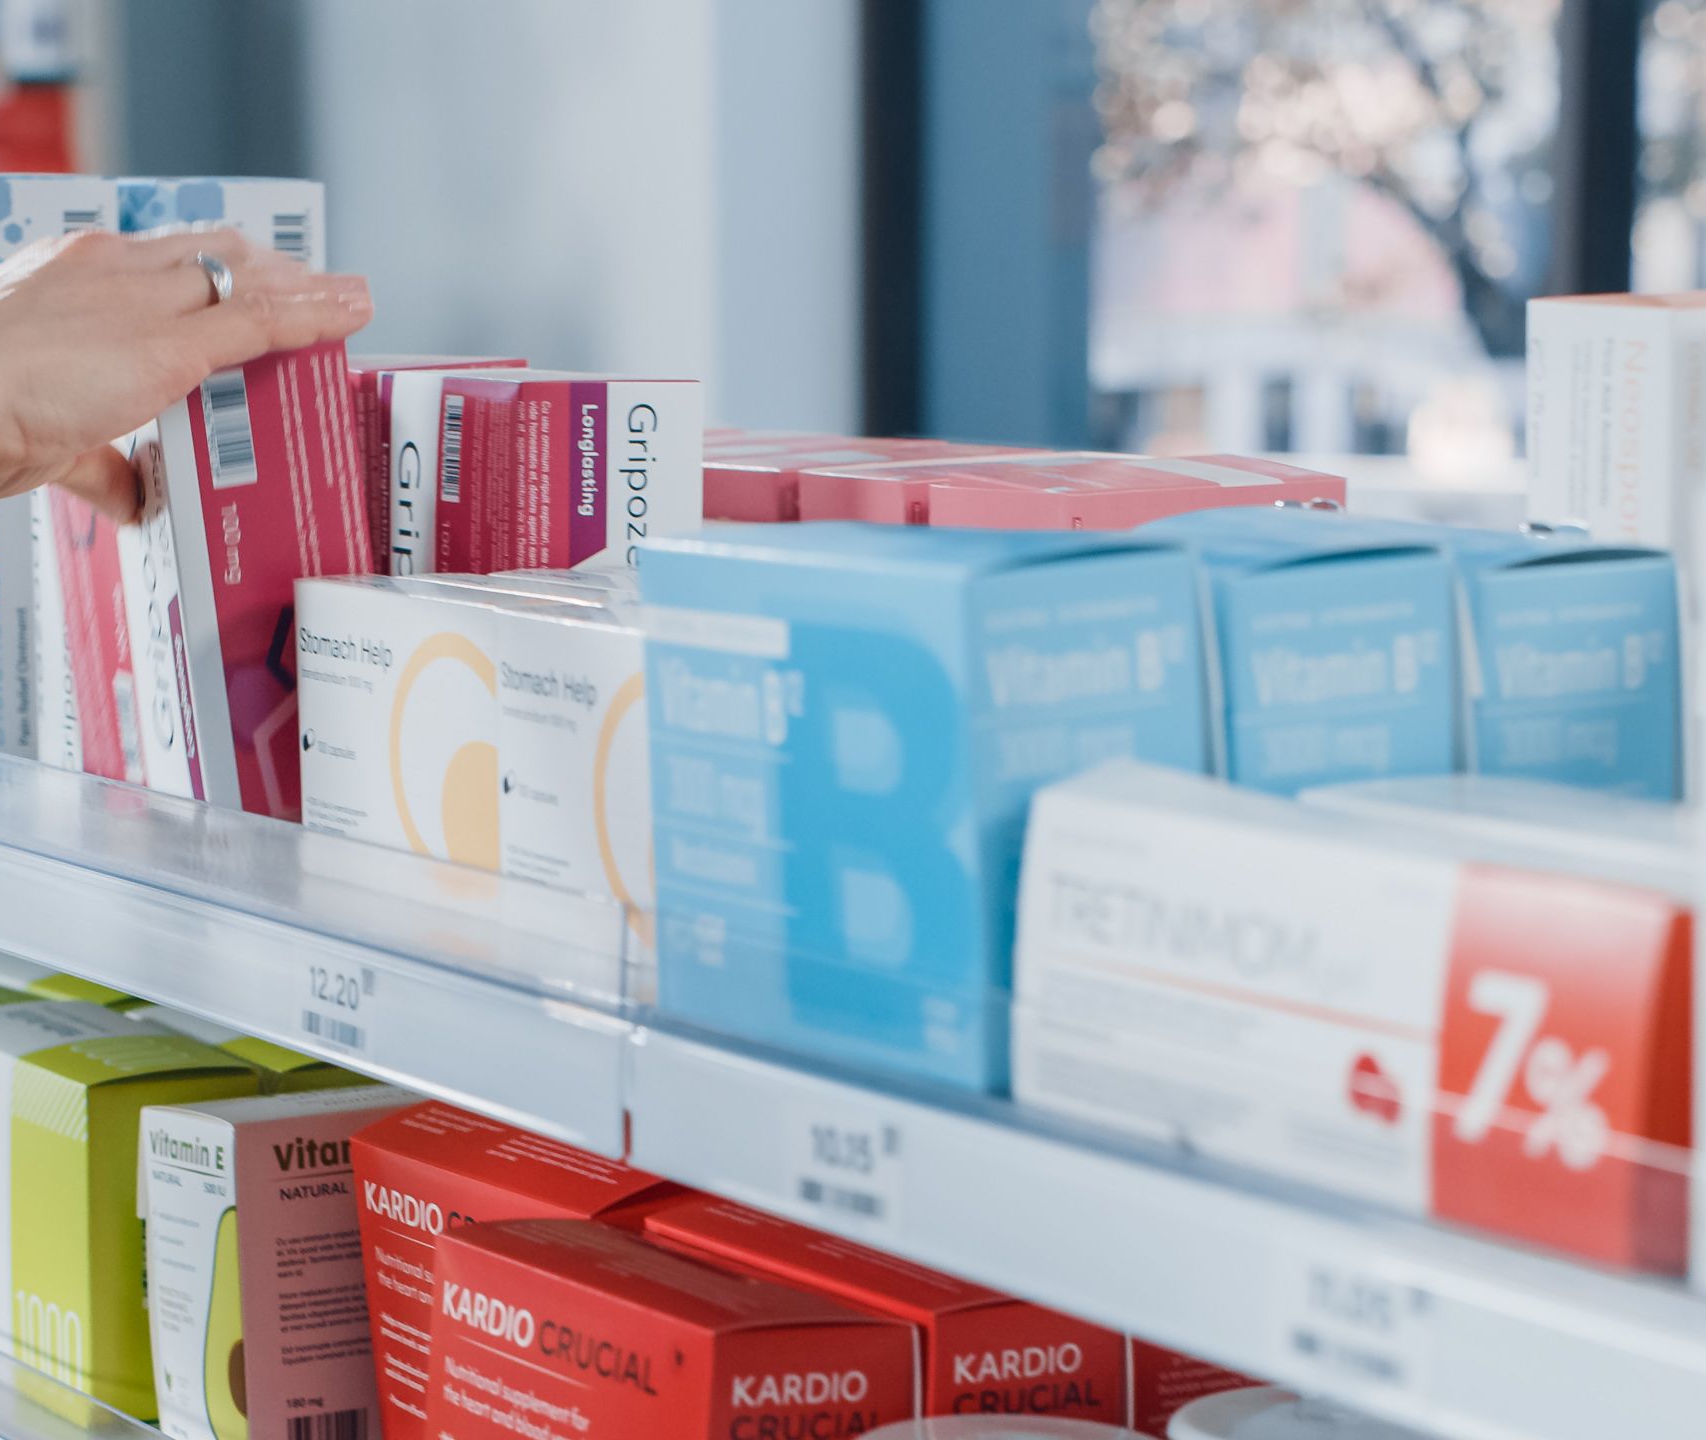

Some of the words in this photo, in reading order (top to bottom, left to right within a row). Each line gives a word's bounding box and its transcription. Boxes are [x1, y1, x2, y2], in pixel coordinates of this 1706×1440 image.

[578, 403, 598, 517] Longlasting
[393, 441, 421, 576] Grip
[299, 626, 357, 664] Stomach
[359, 637, 393, 673] Help
[1252, 635, 1387, 707] Vitamin
[1496, 633, 1617, 698] Vitamin
[501, 660, 559, 699] Stomach
[563, 671, 598, 713] Help
[310, 965, 360, 1012] 12.20
[1454, 966, 1611, 1172] 7%
[149, 1130, 210, 1167] Vitamin
[214, 1145, 225, 1171] E
[272, 1136, 351, 1173] Vita
[279, 1181, 349, 1201] NATURAL
[363, 1178, 444, 1236] KARDIO
[16, 1288, 83, 1394] 1000
[441, 1279, 535, 1349] KARDIO
[538, 1318, 659, 1397] CRUCIAL
[952, 1342, 1083, 1385] KARDIO
[443, 1381, 461, 1408] the
[461, 1388, 491, 1419] heart
[491, 1406, 515, 1431] and
[444, 1354, 502, 1397] Nutritional
[501, 1385, 572, 1425] supplement
[571, 1406, 591, 1432] for
[730, 1369, 869, 1408] KARDIO
